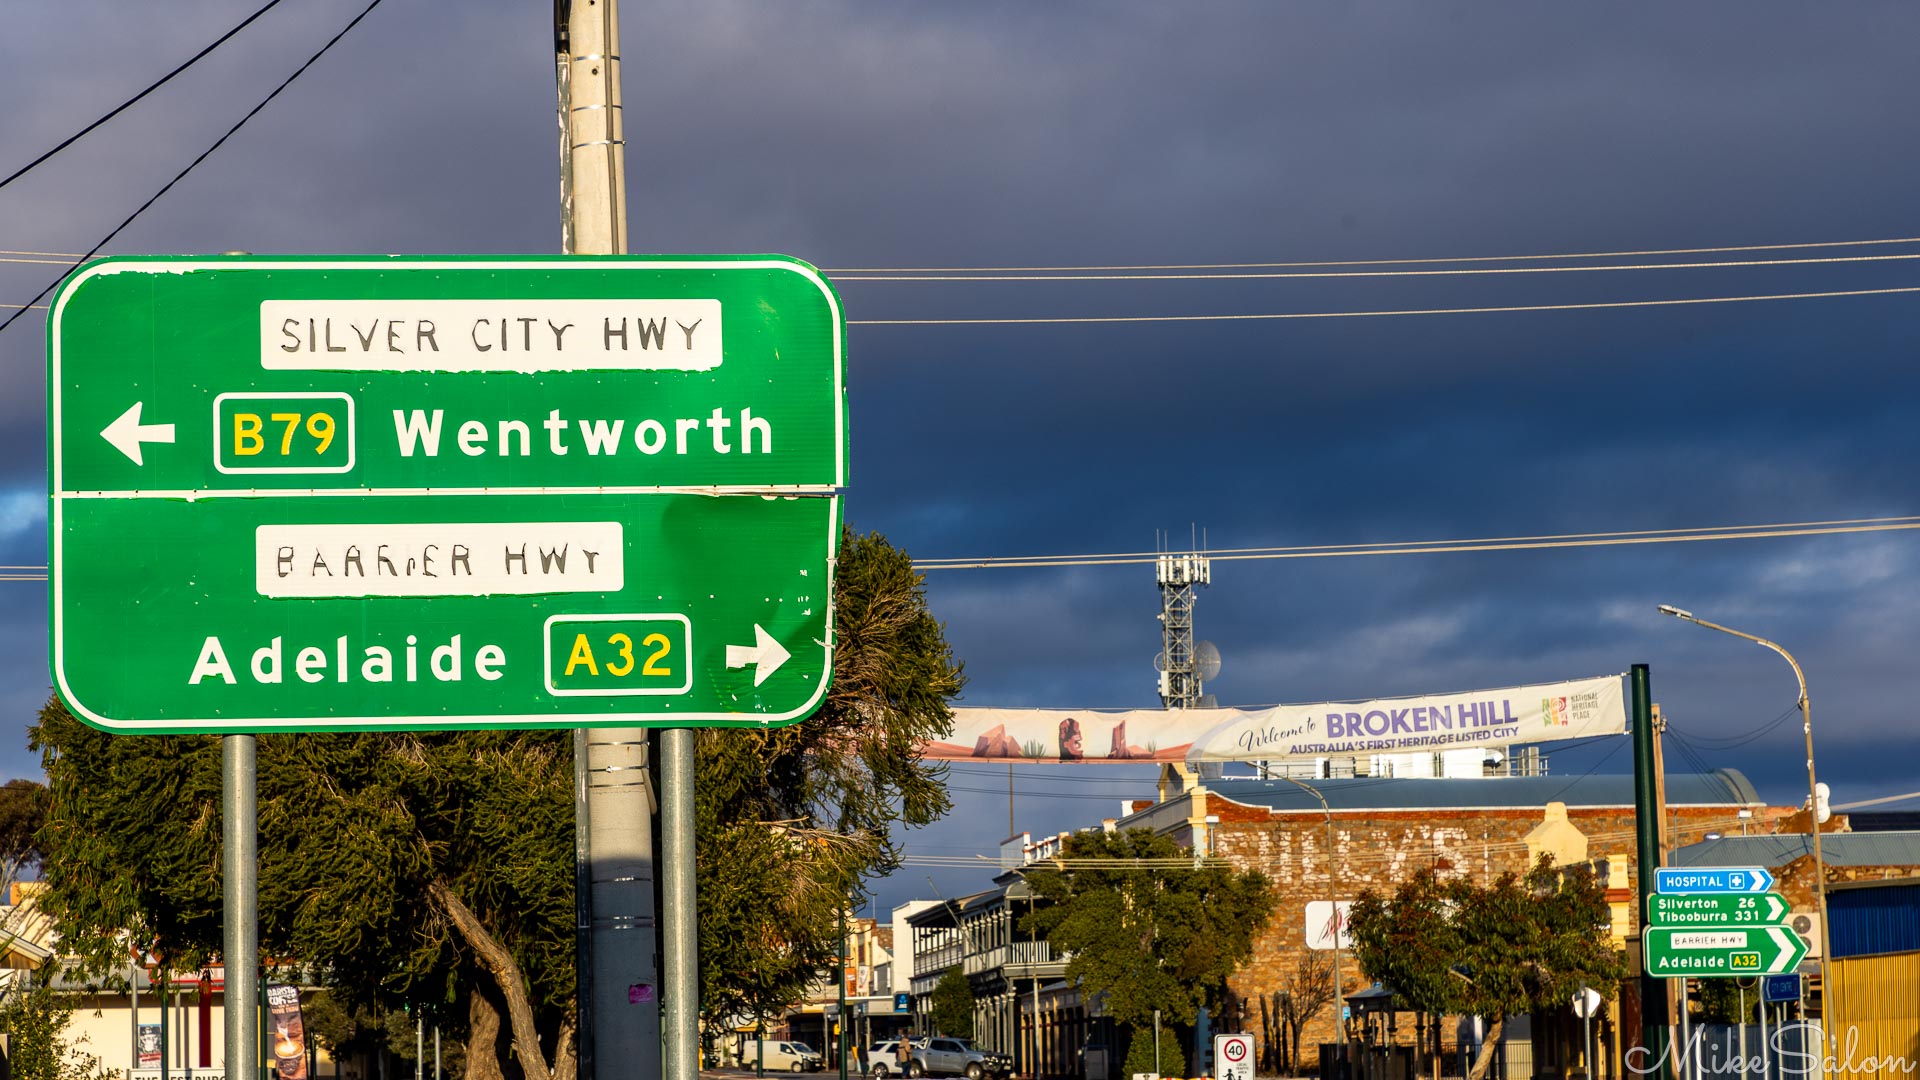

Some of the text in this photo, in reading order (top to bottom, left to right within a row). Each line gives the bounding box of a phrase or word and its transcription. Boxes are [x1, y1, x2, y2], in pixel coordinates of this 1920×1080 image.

[281, 316, 703, 354] SILVER CITY HWY
[233, 406, 773, 458] B79 Wentworth
[505, 542, 600, 575] HWY
[188, 633, 671, 685] Adelaide A32
[1570, 692, 1598, 703] NATIONAL
[1571, 701, 1599, 711] HERITAGE
[1326, 700, 1518, 738] BROKEN HILL
[1572, 710, 1590, 720] PLACE
[1238, 716, 1316, 752] Welcome to
[1289, 727, 1519, 754] AUSTRALIA'S FIRST HERITAGE LISTED CITY
[1666, 876, 1723, 887] HOSPITAL
[1658, 897, 1756, 909] Silverton 26
[1658, 910, 1759, 922] Tibooburra 331
[1674, 936, 1744, 945] BARRIER HWY
[1658, 955, 1757, 968] Adelaide A32
[1228, 1045, 1243, 1055] 40
